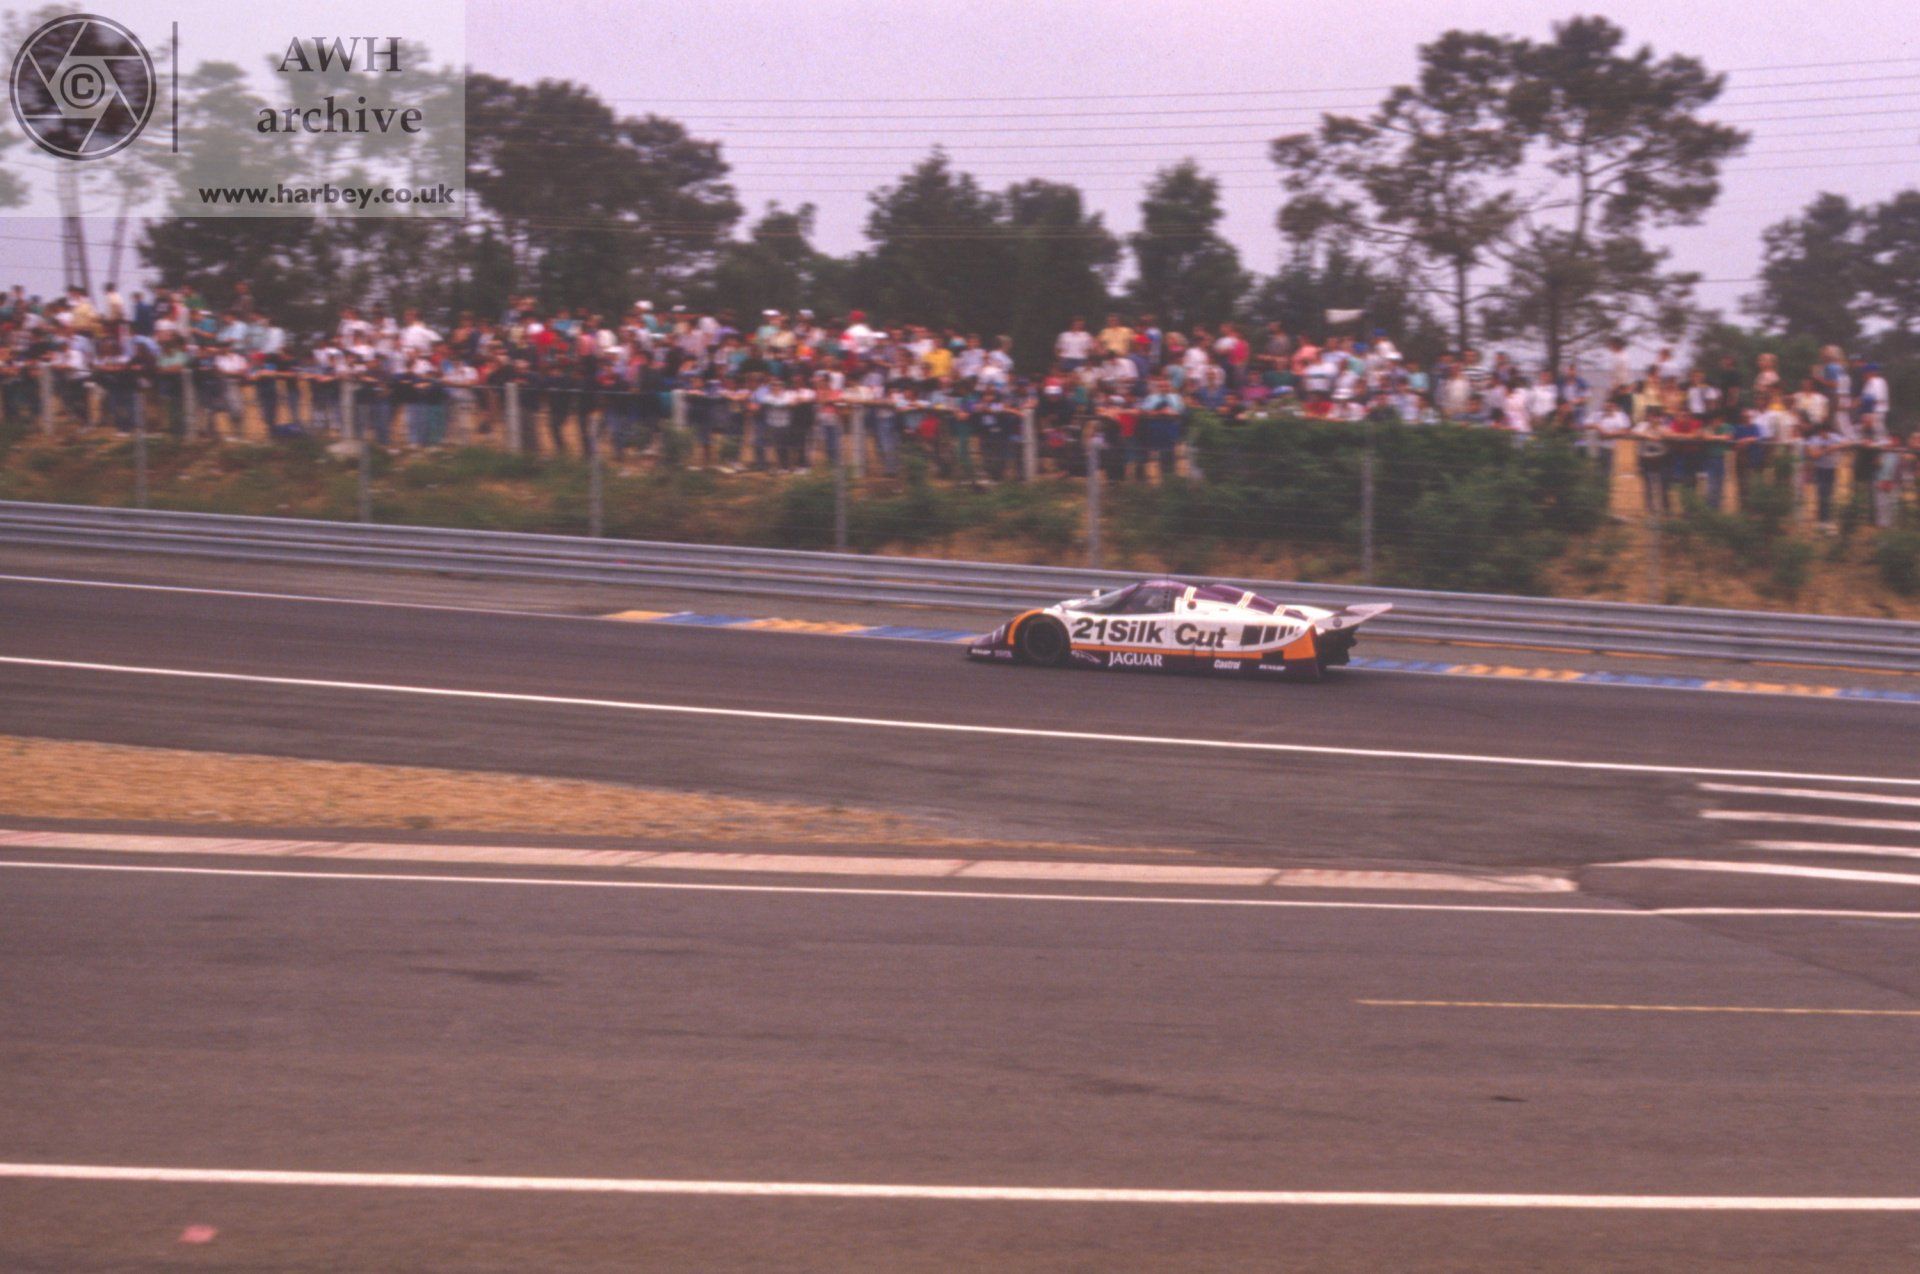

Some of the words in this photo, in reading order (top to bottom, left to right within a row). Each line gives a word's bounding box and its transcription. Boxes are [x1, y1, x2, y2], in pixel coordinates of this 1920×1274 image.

[1107, 618, 1163, 644] Silk
[1175, 622, 1227, 648] Cut
[1108, 651, 1163, 668] JAGUAR
